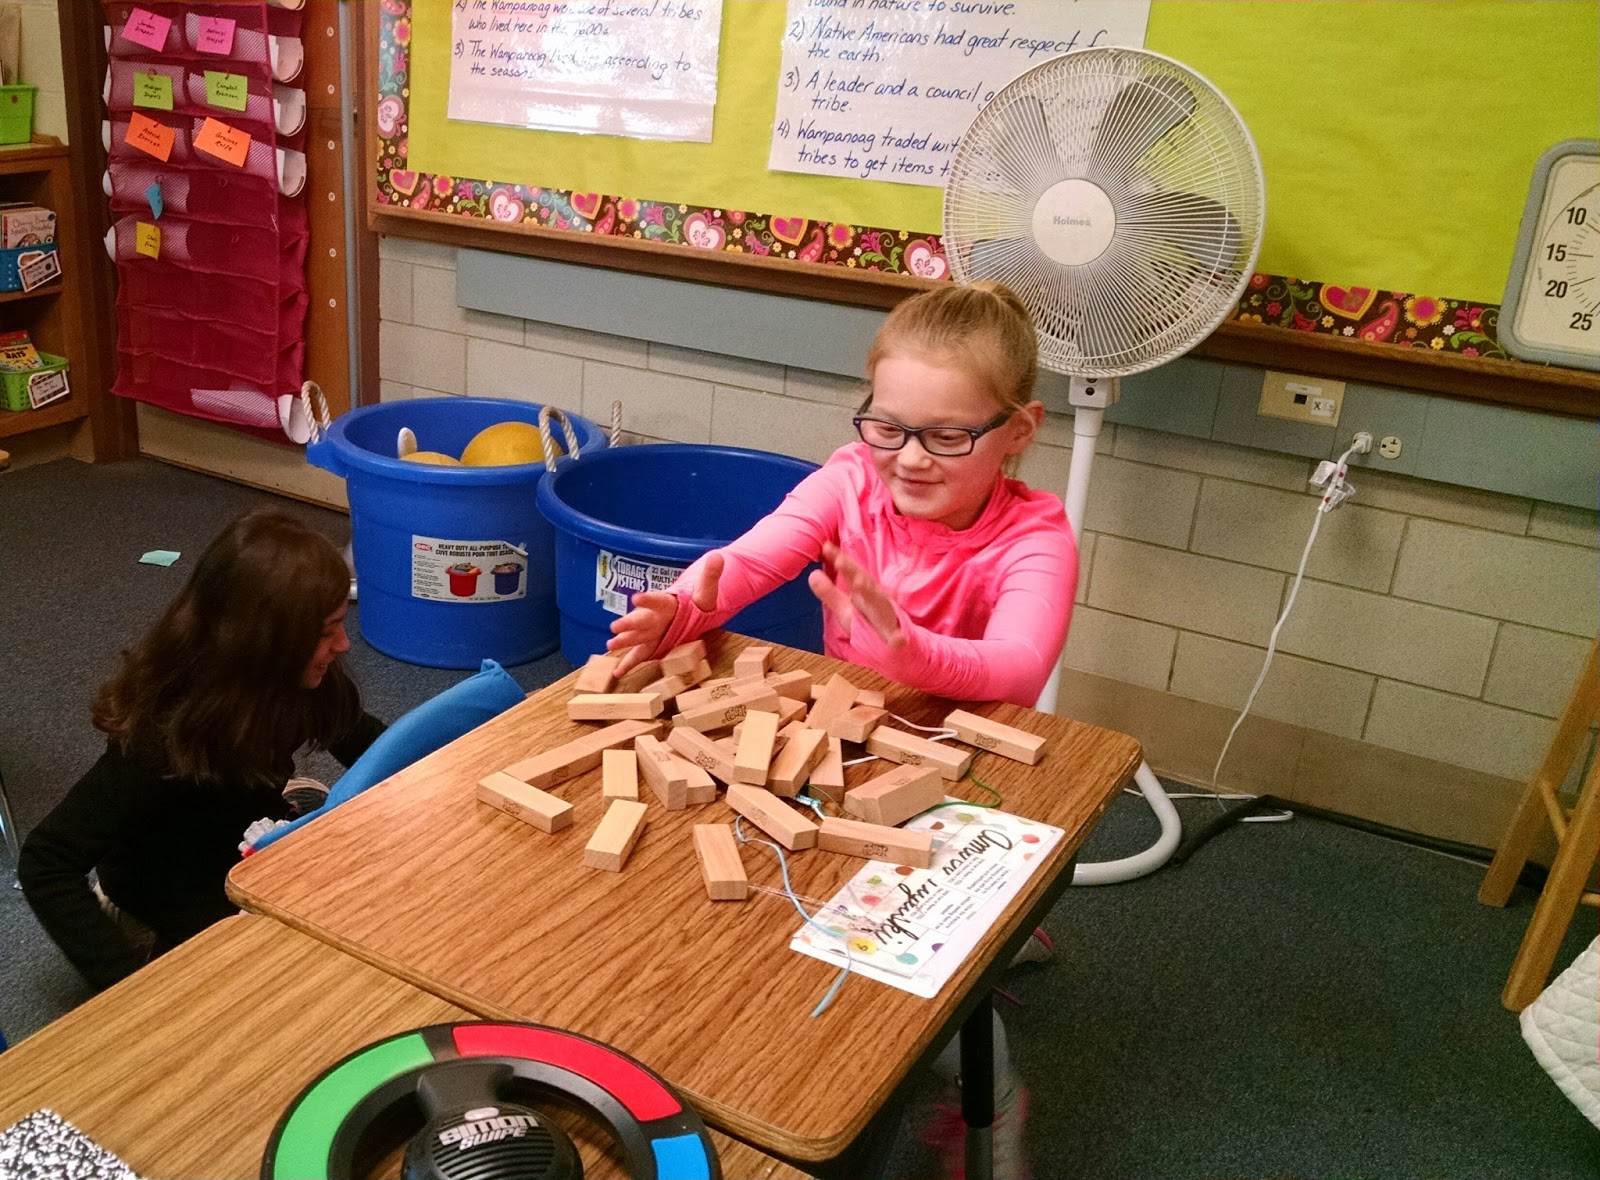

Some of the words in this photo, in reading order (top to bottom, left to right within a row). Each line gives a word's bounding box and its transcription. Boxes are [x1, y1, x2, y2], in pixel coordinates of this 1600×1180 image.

[491, 0, 551, 18] Wampanoag
[663, 1, 703, 20] tribes
[868, 0, 921, 12] nature
[928, 0, 947, 12] to
[949, 1, 1016, 16] survive.
[468, 14, 487, 30] who
[489, 16, 512, 32] lived
[513, 17, 534, 33] here
[536, 23, 548, 34] in
[809, 15, 857, 41] Native
[858, 21, 930, 46] Americans
[933, 24, 967, 46] had
[967, 28, 1011, 57] great
[1009, 30, 1081, 58] respect
[469, 39, 487, 58] The
[490, 42, 547, 68] Wampanoag
[604, 54, 668, 81] according
[675, 51, 691, 71] to
[807, 41, 831, 60] the
[838, 45, 886, 63] earth.
[471, 61, 487, 77] the
[805, 69, 820, 93] A
[823, 71, 874, 94] leader
[874, 78, 907, 96] and
[907, 84, 919, 97] a
[925, 81, 983, 102] council
[811, 92, 853, 113] tribe.
[797, 117, 876, 153] Wampanoag
[882, 127, 933, 151] traded
[931, 136, 961, 153] wit
[798, 144, 837, 166] tribes
[844, 151, 860, 169] to
[860, 155, 888, 179] get
[891, 156, 934, 175] items
[1053, 216, 1092, 226] Holmes
[1566, 206, 1588, 226] 10
[1546, 243, 1568, 262] 15
[1545, 280, 1568, 299] 20
[1569, 311, 1593, 332] 25
[438, 543, 454, 551] HEAVY
[724, 704, 747, 722] Jenga
[695, 751, 717, 769] Jenga
[459, 1127, 529, 1151] SWIPE
